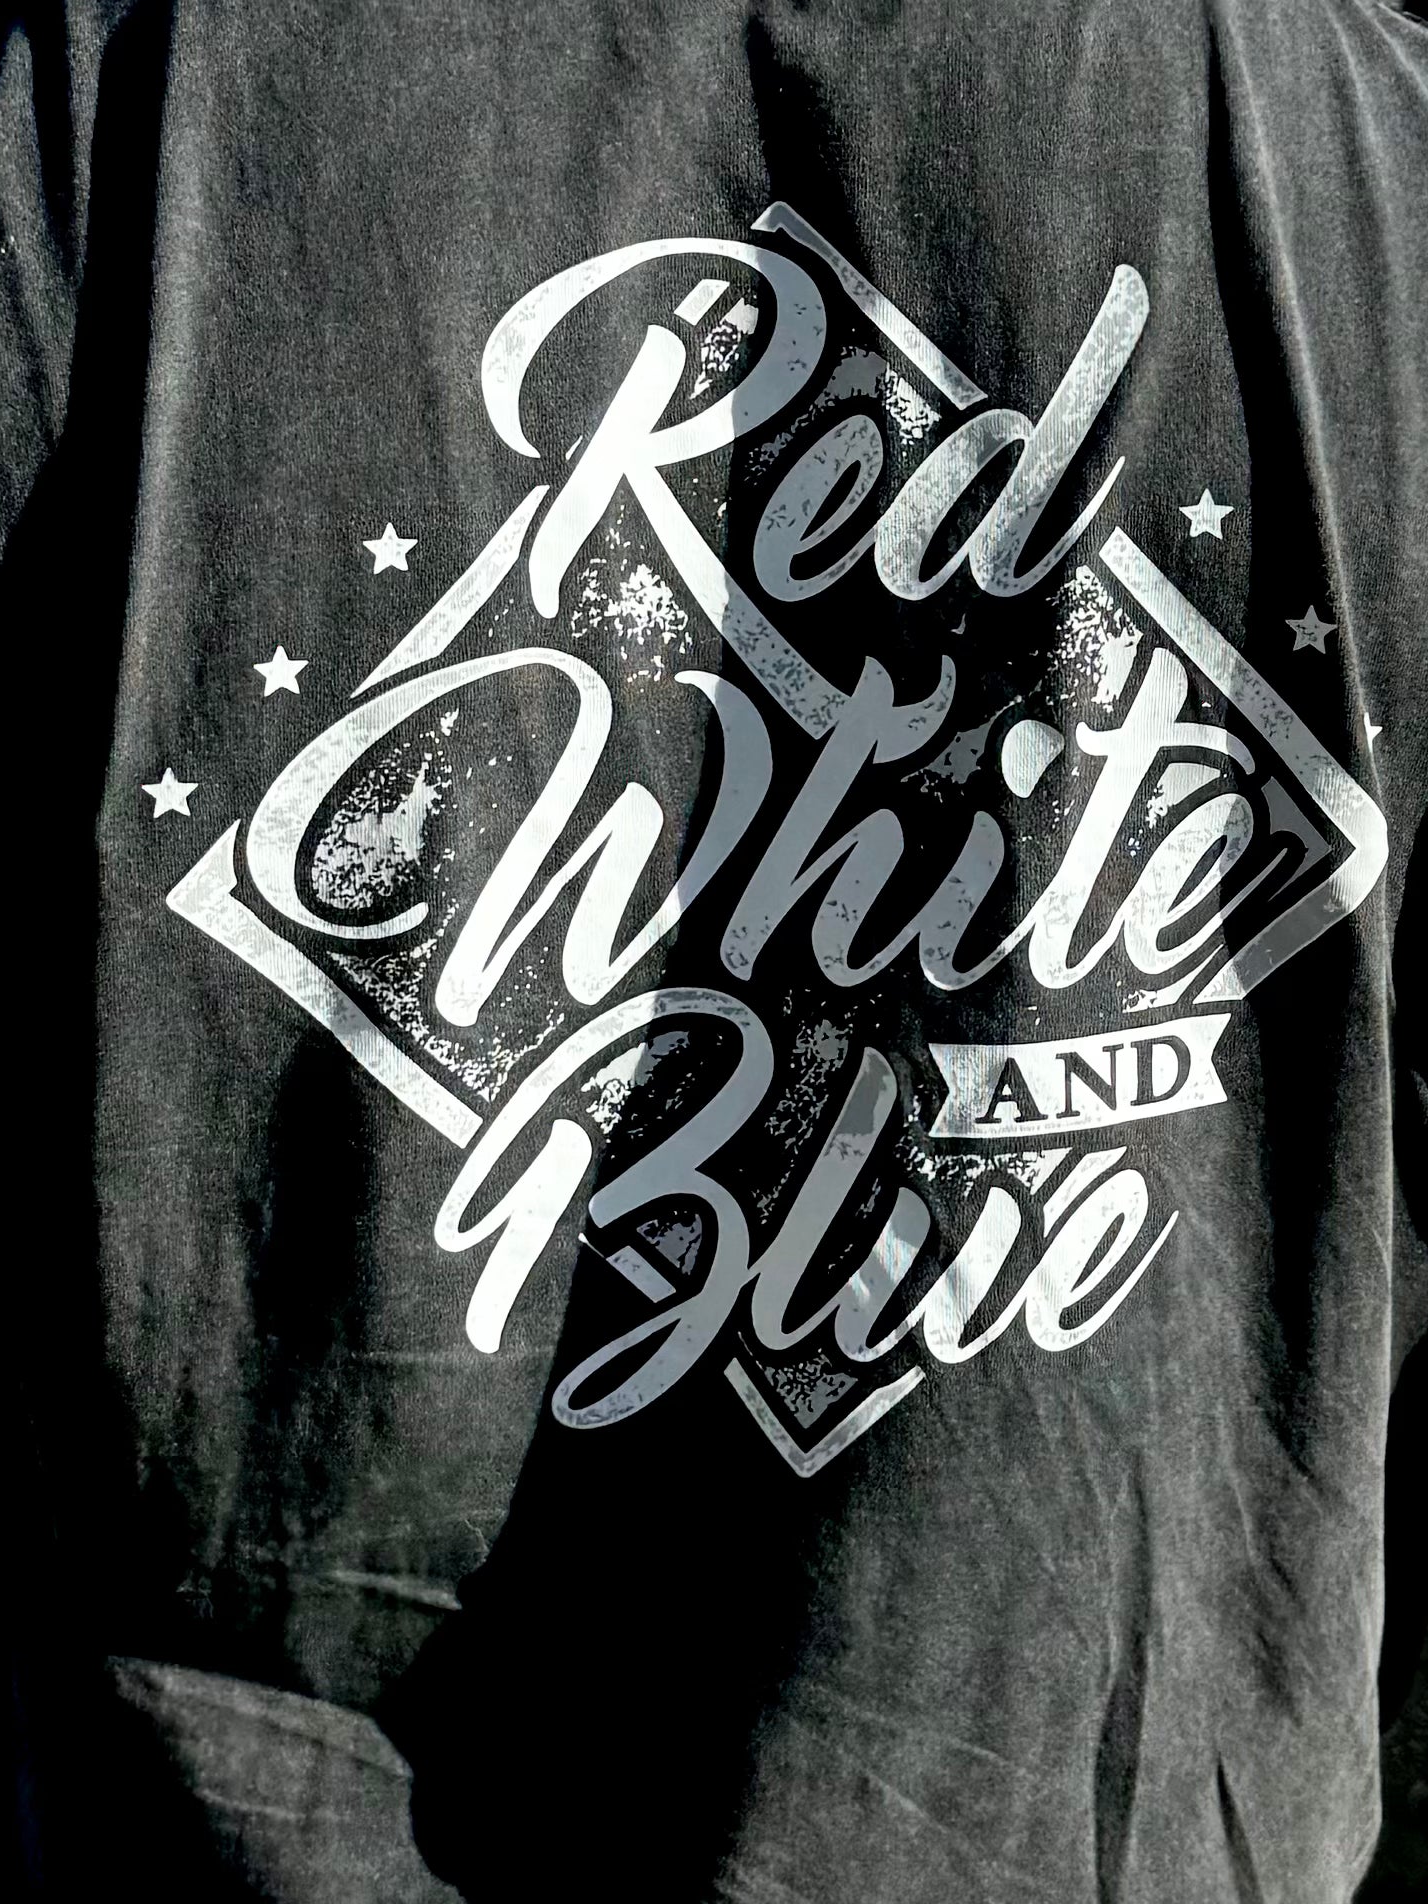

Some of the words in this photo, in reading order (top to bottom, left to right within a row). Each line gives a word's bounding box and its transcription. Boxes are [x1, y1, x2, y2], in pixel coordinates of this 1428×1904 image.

[480, 234, 1151, 738] Red
[248, 644, 1332, 1028] White
[432, 984, 1180, 1429] Blue
[983, 1034, 1194, 1128] AND
